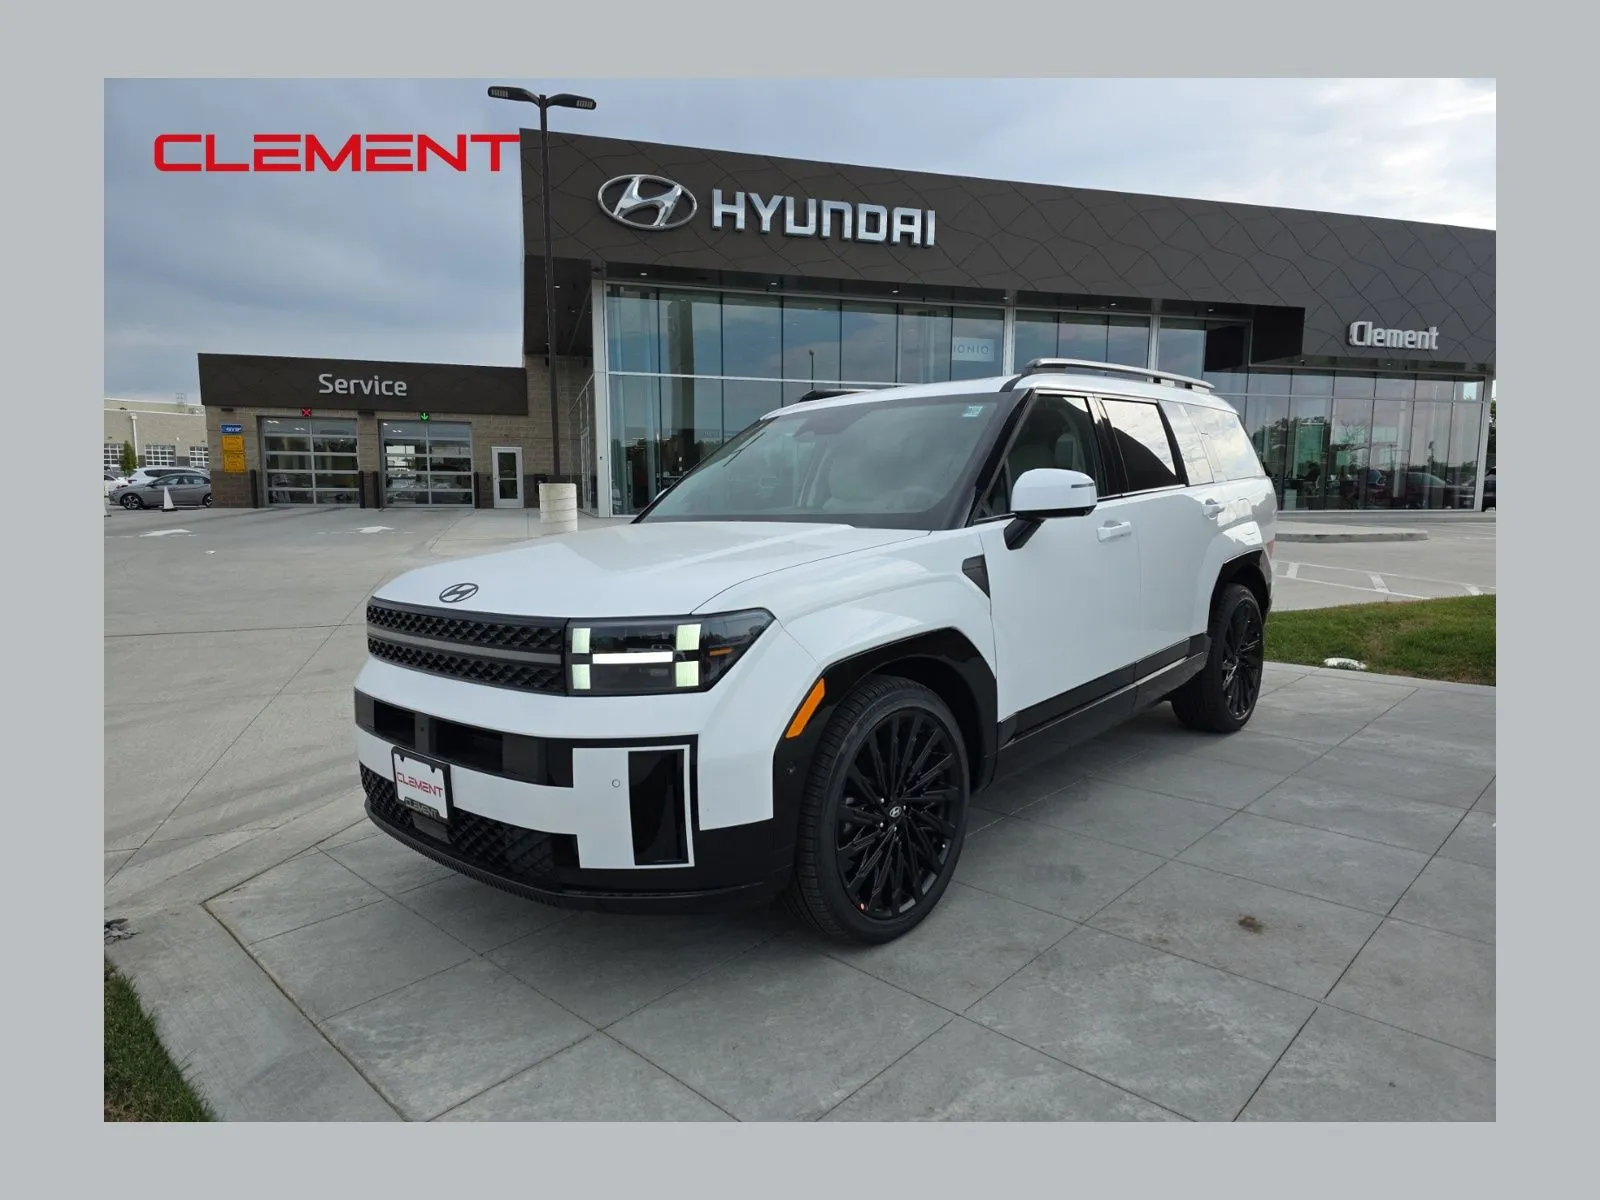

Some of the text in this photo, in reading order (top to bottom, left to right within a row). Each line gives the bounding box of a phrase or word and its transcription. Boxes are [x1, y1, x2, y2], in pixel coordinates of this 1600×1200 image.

[710, 187, 937, 247] HYUNDAI
[1349, 320, 1439, 350] Clement
[953, 343, 990, 355] IONIQ
[318, 373, 408, 397] Service
[396, 771, 444, 798] CLEMENT
